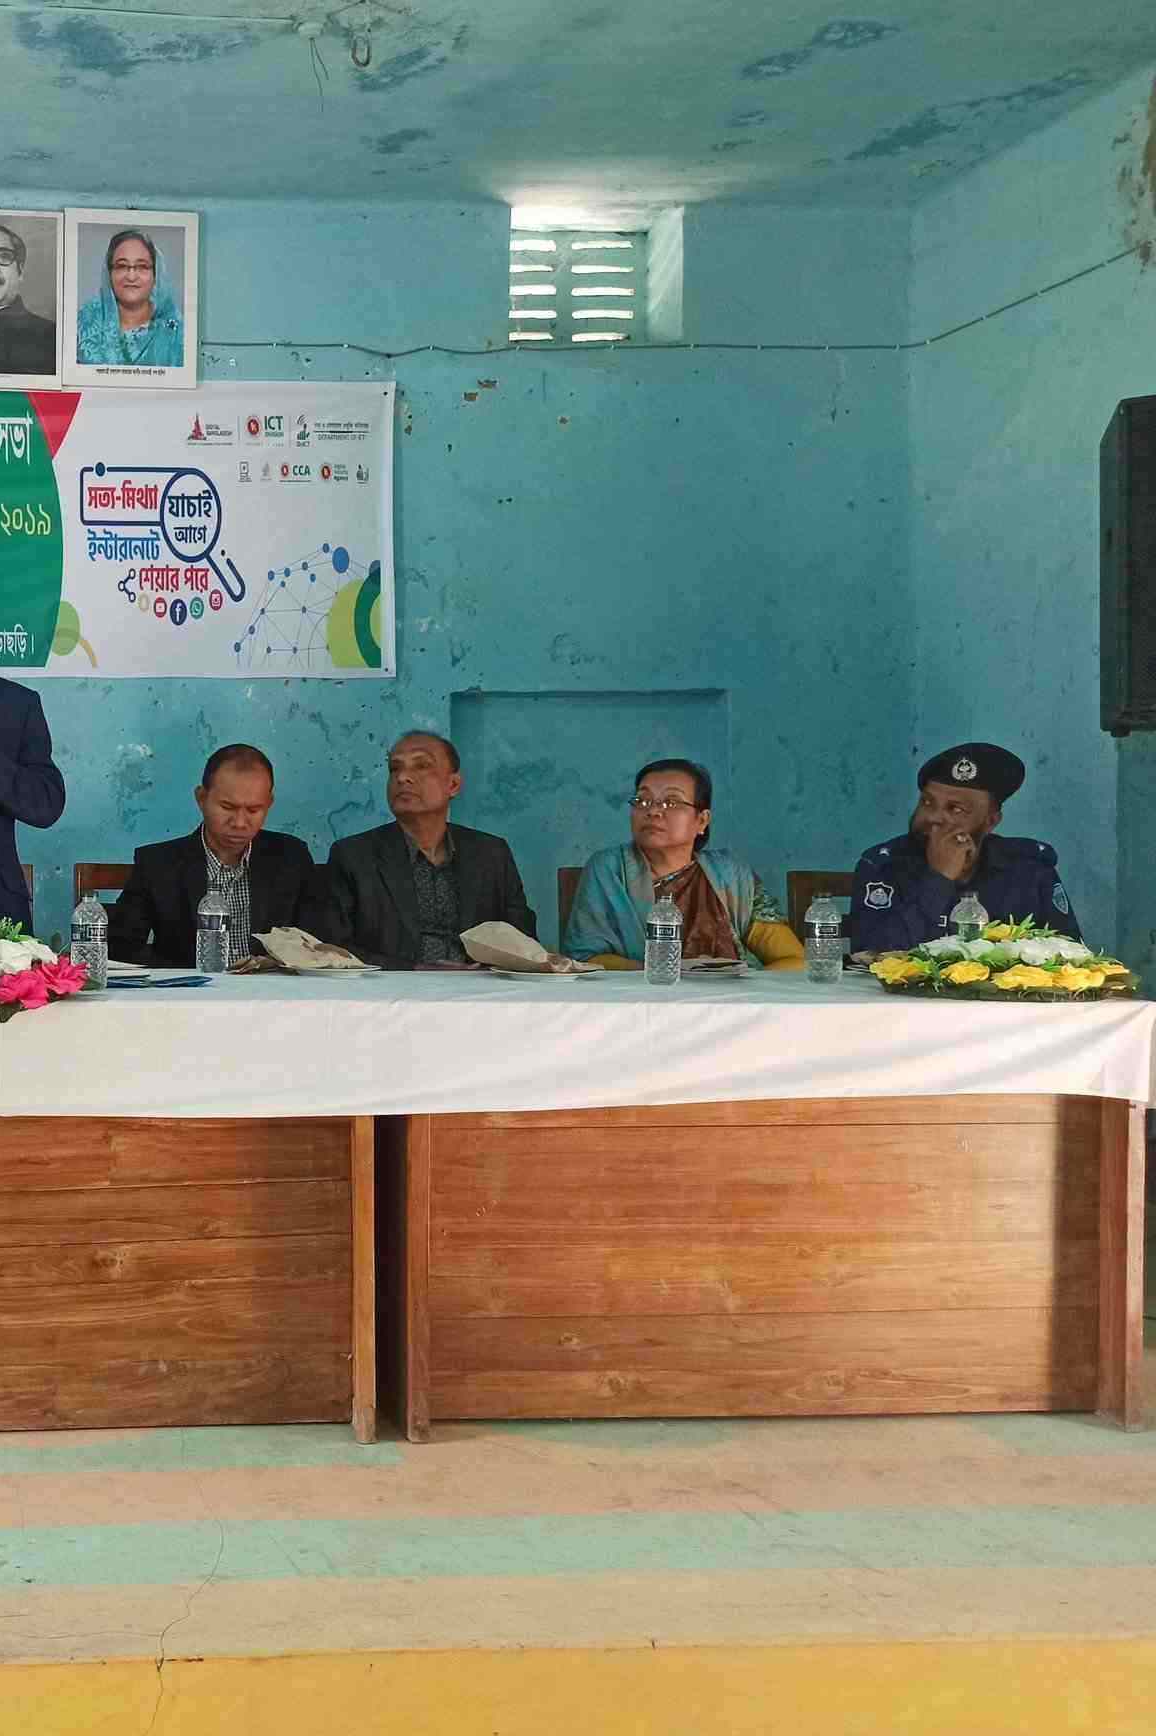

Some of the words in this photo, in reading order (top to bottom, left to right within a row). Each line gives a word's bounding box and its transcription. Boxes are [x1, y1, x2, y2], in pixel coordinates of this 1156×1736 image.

[264, 415, 284, 431] ICT
[292, 464, 311, 476] CCA
[87, 480, 159, 510] সত্য-মিথ্যা
[167, 490, 213, 518] যাচাই
[0, 503, 52, 537] ২০১৯
[87, 529, 160, 562] ইন্টারনেটে
[173, 526, 207, 544] আগে
[139, 565, 180, 592] শেয়ার
[184, 565, 210, 592] পরে
